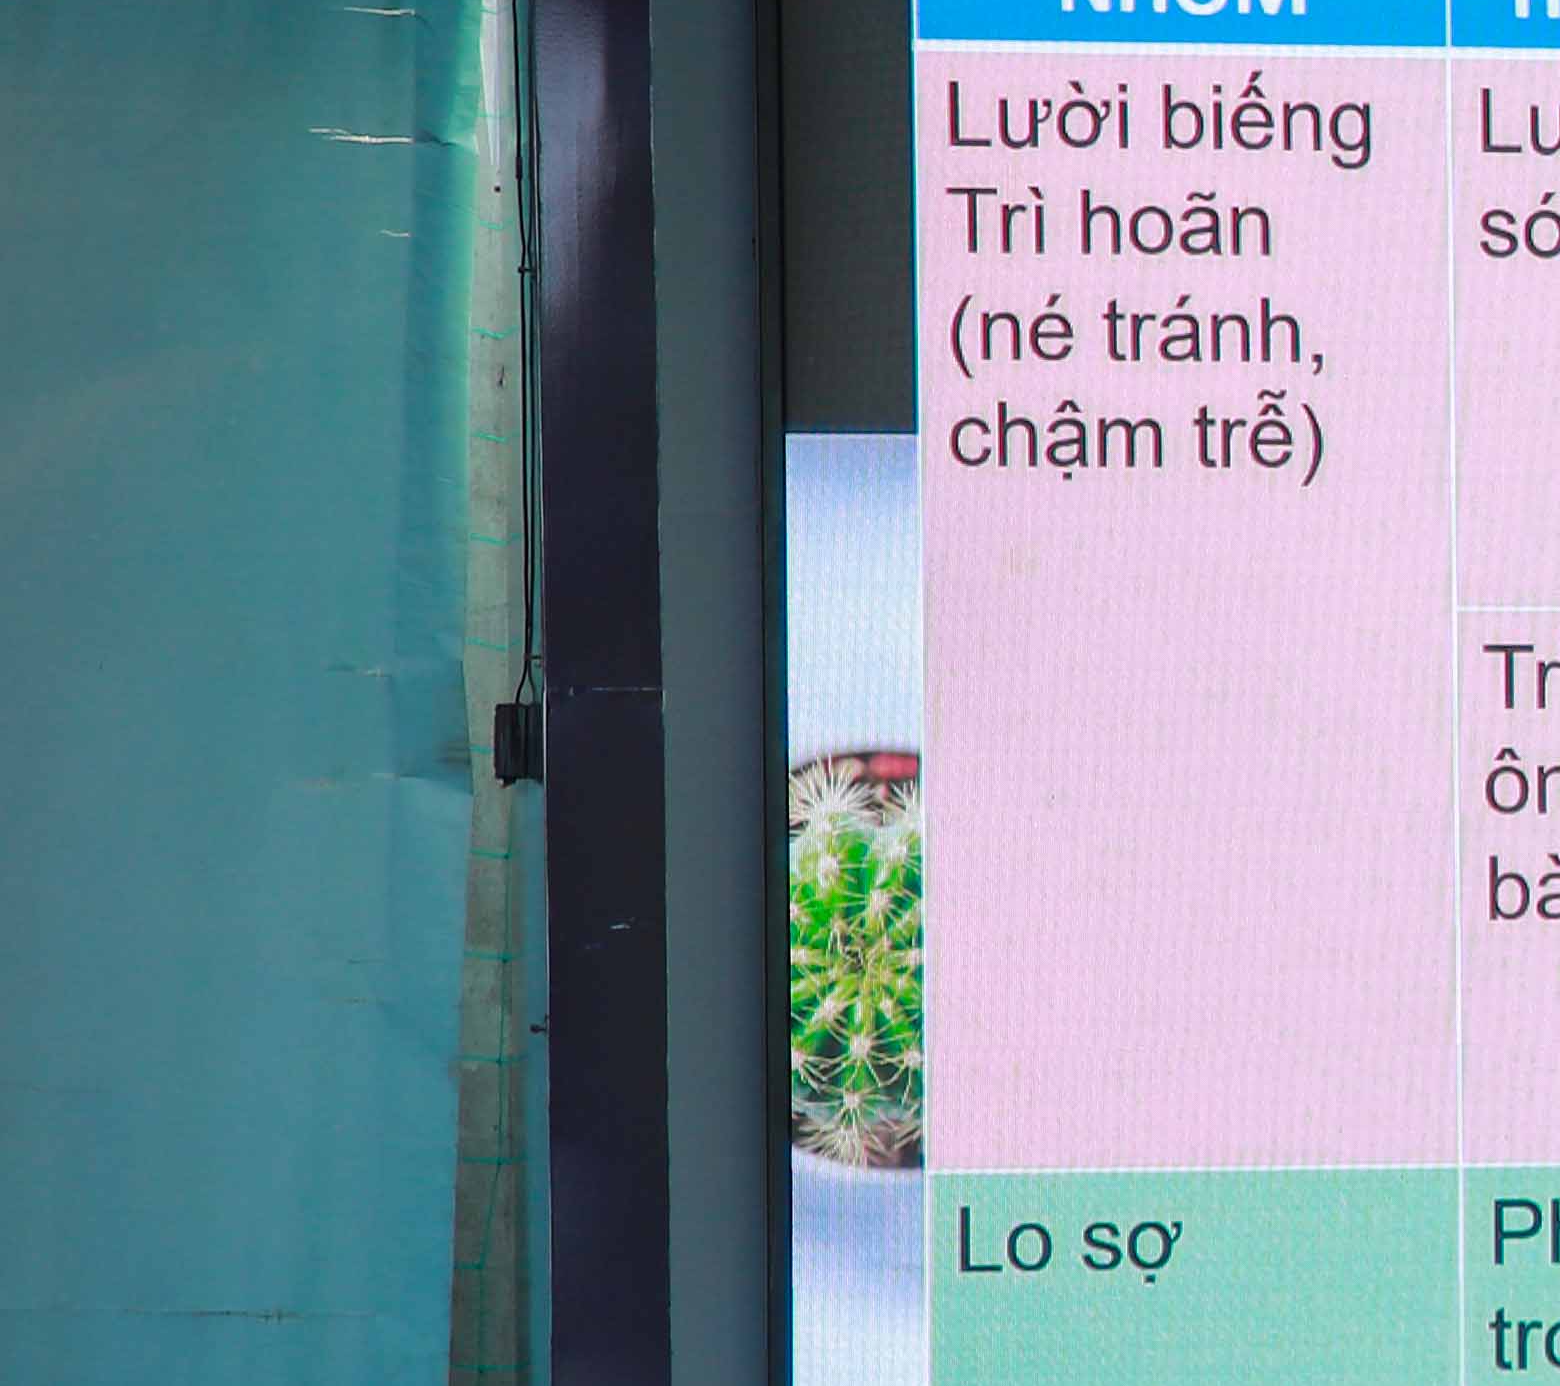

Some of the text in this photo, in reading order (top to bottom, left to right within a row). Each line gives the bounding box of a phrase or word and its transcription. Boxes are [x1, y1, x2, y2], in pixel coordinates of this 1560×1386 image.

[946, 68, 1374, 172] Lười biếng
[943, 184, 1273, 258] Trì hoãn
[949, 291, 1325, 381] (né tránh,
[948, 387, 1326, 489] chậm trễ)
[958, 1204, 1185, 1286] Lo sợ
